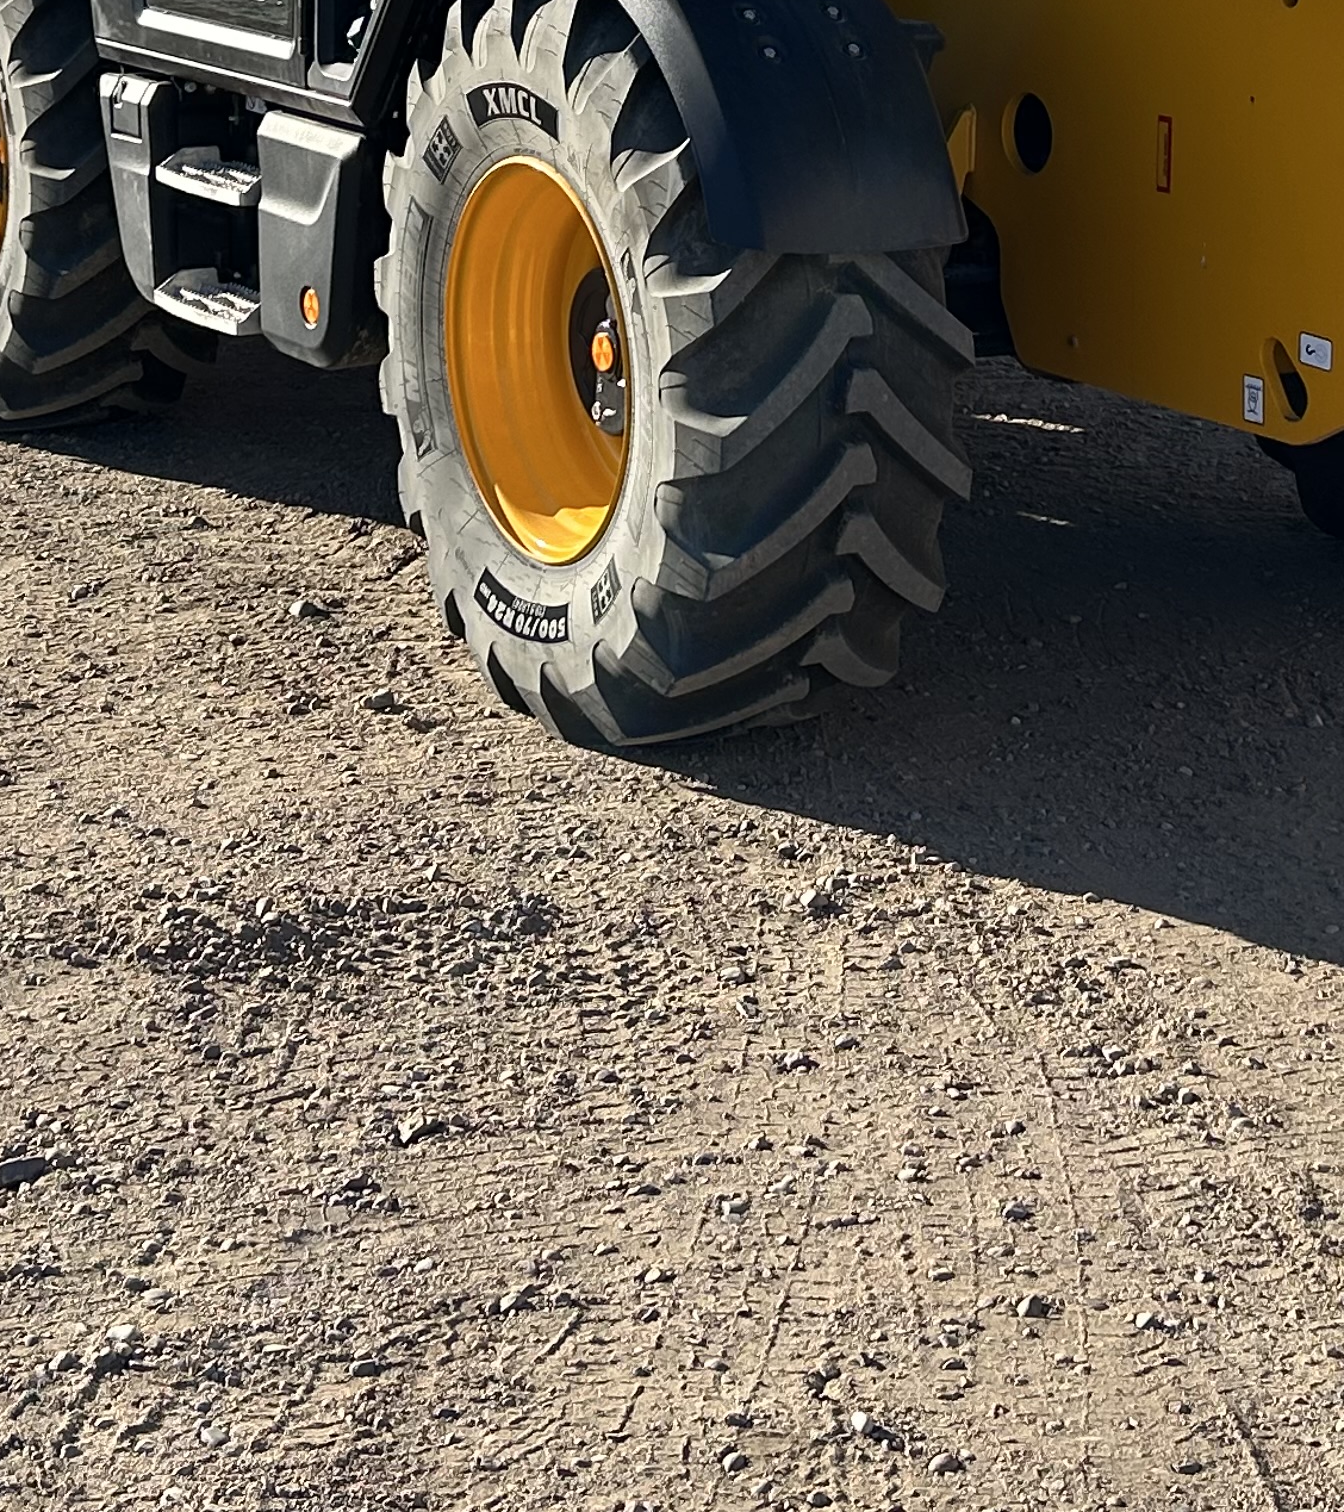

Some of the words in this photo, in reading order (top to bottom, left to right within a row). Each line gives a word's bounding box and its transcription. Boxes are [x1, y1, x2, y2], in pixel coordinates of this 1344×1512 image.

[482, 87, 542, 125] XMCL
[401, 202, 425, 402] MICHELIN
[514, 612, 566, 639] 500/70
